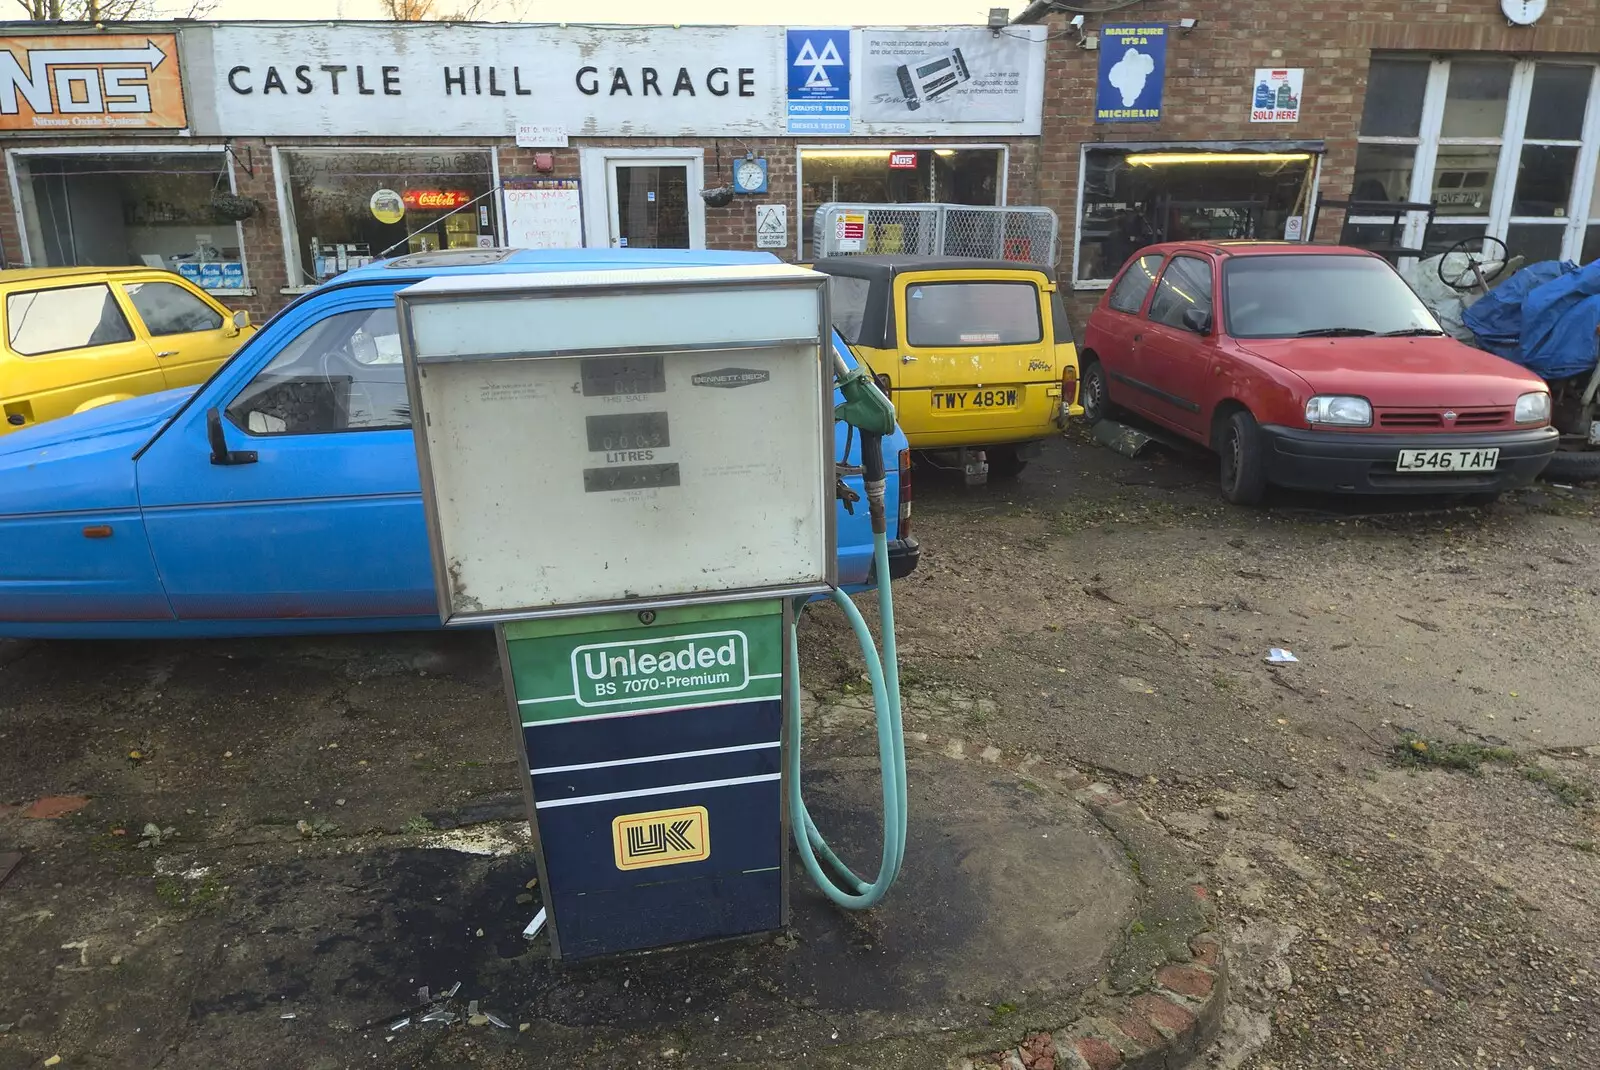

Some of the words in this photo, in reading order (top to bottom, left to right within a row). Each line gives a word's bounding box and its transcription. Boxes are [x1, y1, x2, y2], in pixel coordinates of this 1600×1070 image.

[899, 40, 927, 49] important
[928, 41, 949, 49] people
[1121, 37, 1138, 45] IT'S
[1139, 37, 1148, 45] A
[0, 46, 160, 114] NOS
[227, 65, 402, 96] CASTLE
[444, 65, 532, 96] HILL
[575, 66, 755, 96] GARAGE
[972, 79, 1003, 87] diagnostic
[1098, 109, 1159, 118] MICHELIN
[1253, 111, 1274, 120] SOLD
[1276, 111, 1297, 120] HERE
[32, 117, 69, 126] Nitrous
[72, 117, 103, 126] Oxide
[104, 117, 147, 127] Systems
[508, 192, 537, 202] OPEN
[540, 191, 571, 201] XMAS
[934, 392, 967, 409] TWY
[973, 390, 1017, 408] 483W
[606, 450, 654, 463] LITRES
[1399, 452, 1453, 468] L546
[1460, 451, 1497, 468] TAH
[584, 638, 736, 680] Unleaded
[595, 682, 617, 696] BS
[622, 671, 730, 693] 7070-Premium
[627, 819, 696, 858] UK
